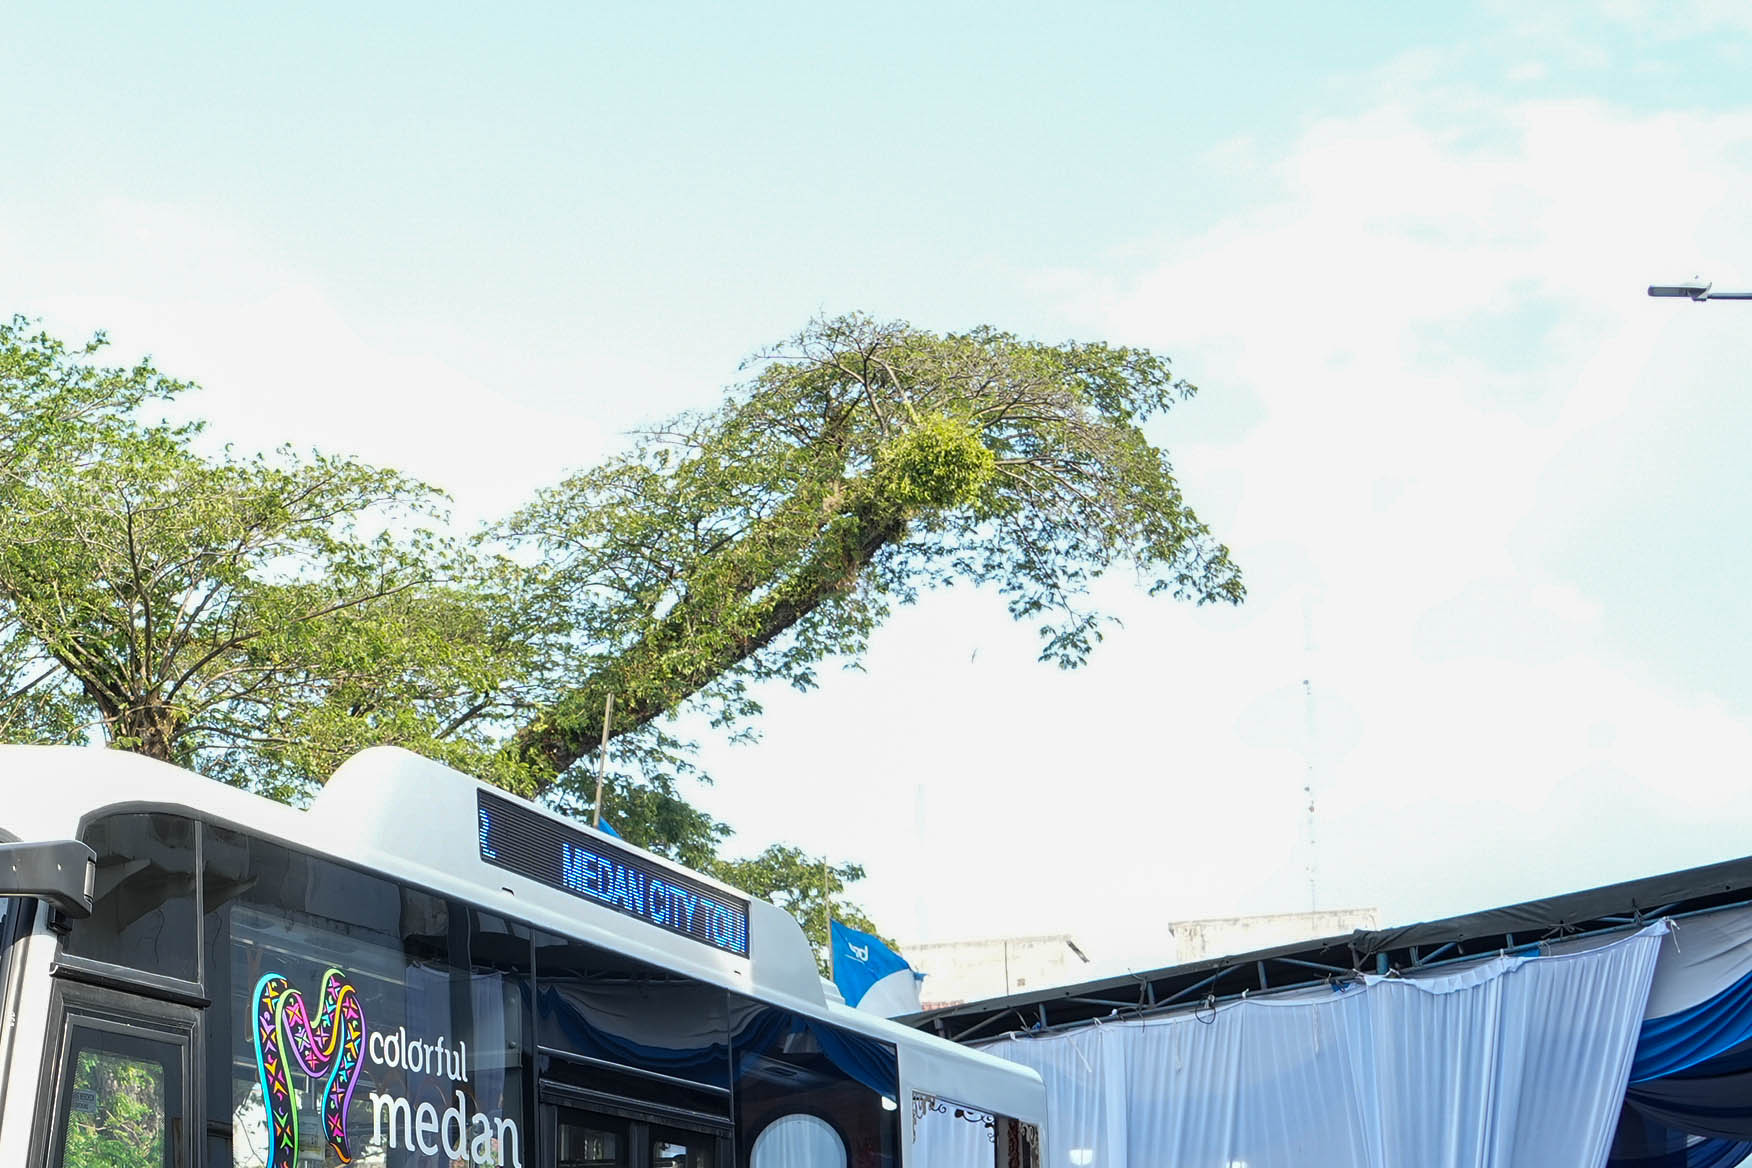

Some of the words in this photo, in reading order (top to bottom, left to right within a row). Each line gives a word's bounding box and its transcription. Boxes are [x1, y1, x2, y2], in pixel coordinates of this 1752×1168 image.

[562, 842, 644, 914] MEDAN
[649, 879, 697, 932] CITY
[700, 898, 746, 952] TOU
[369, 1026, 468, 1083] colorful
